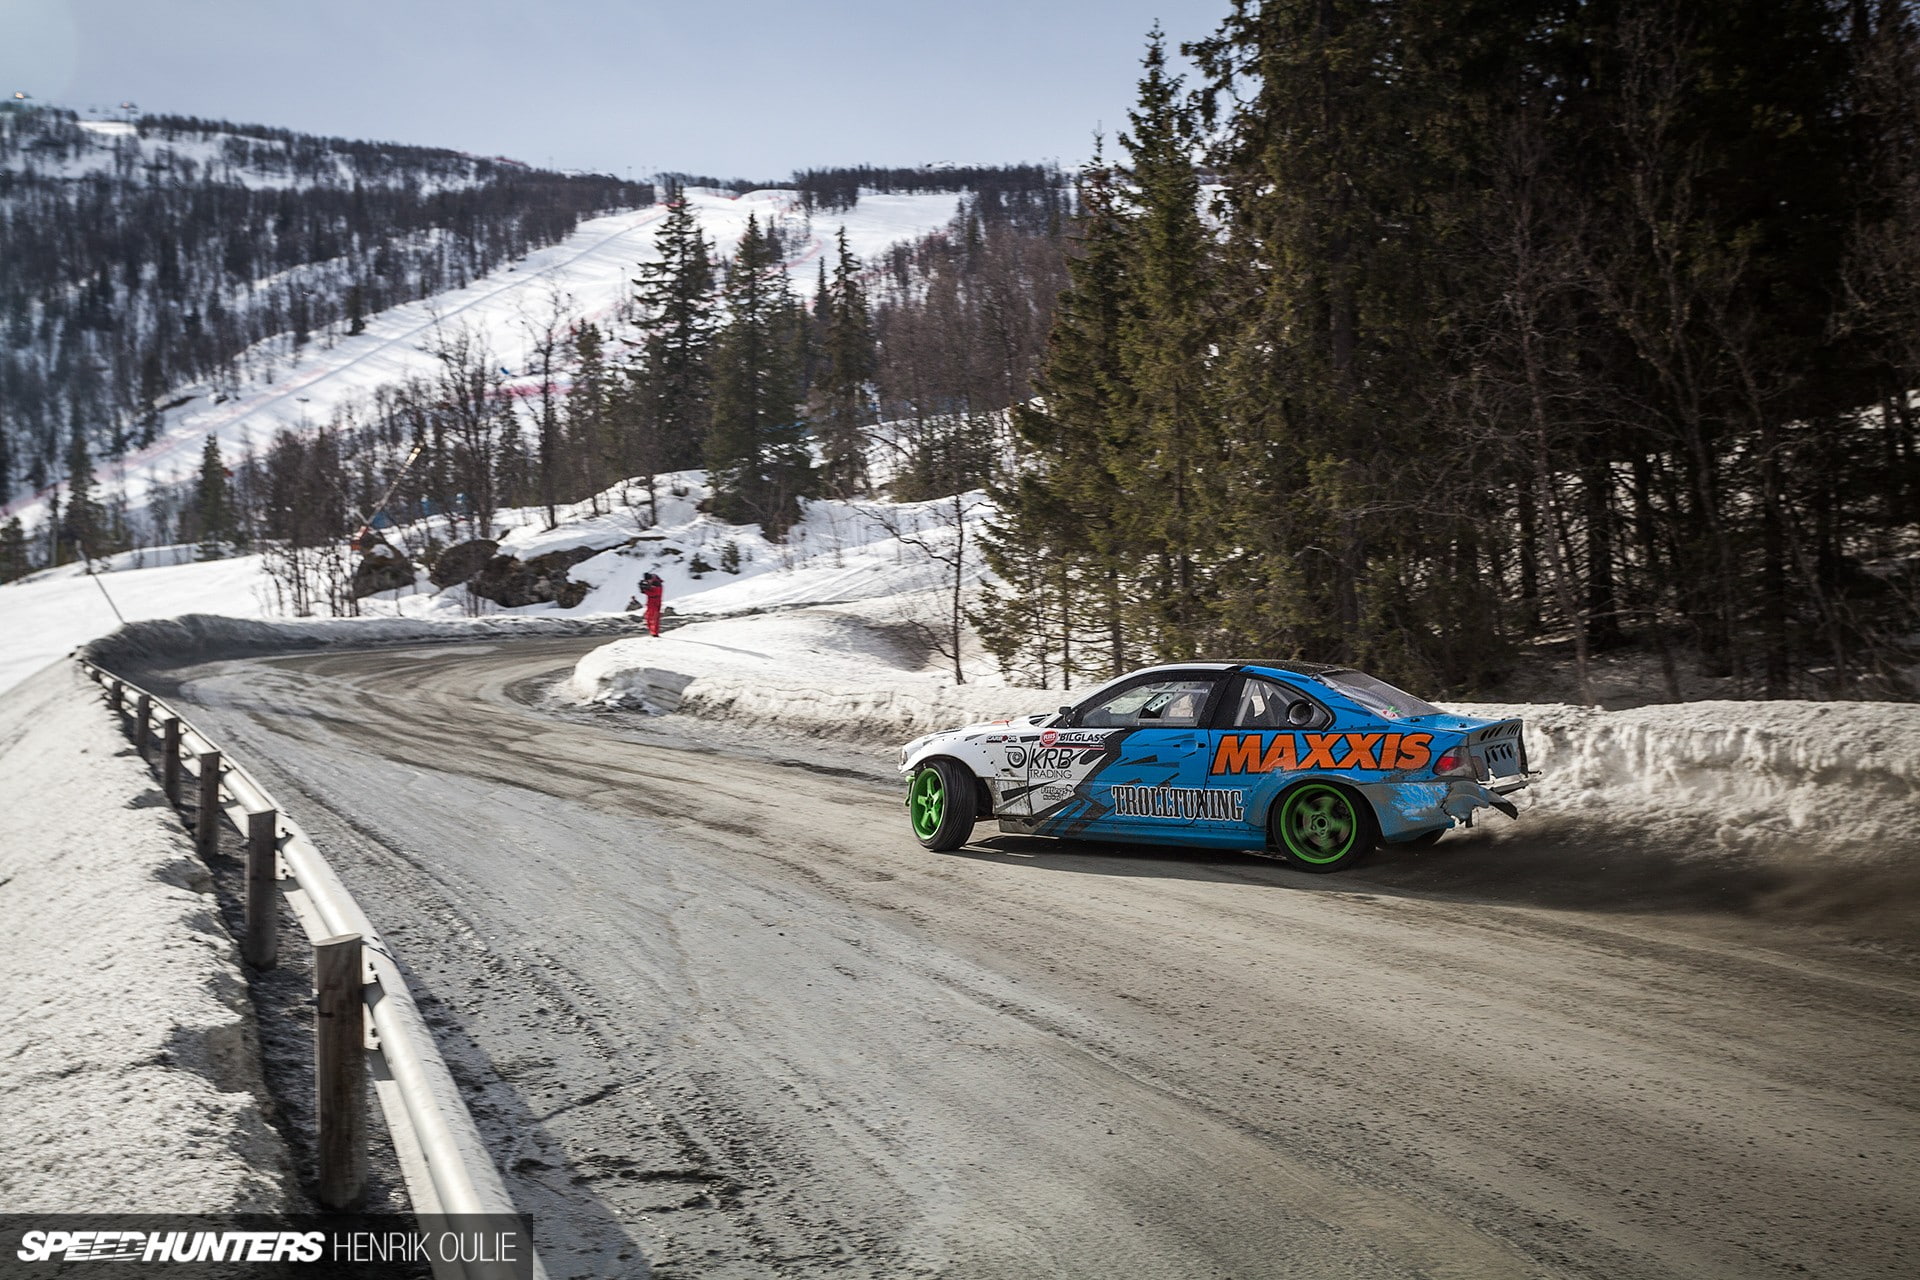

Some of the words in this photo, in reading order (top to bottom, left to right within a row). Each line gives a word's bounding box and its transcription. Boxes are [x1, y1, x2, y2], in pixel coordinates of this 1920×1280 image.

[1059, 733, 1106, 742] BILGLASS
[1029, 748, 1073, 769] KRB
[1210, 732, 1435, 775] MAXXIS
[1029, 769, 1073, 779] TRADING
[1111, 785, 1245, 821] TROLLTUNING
